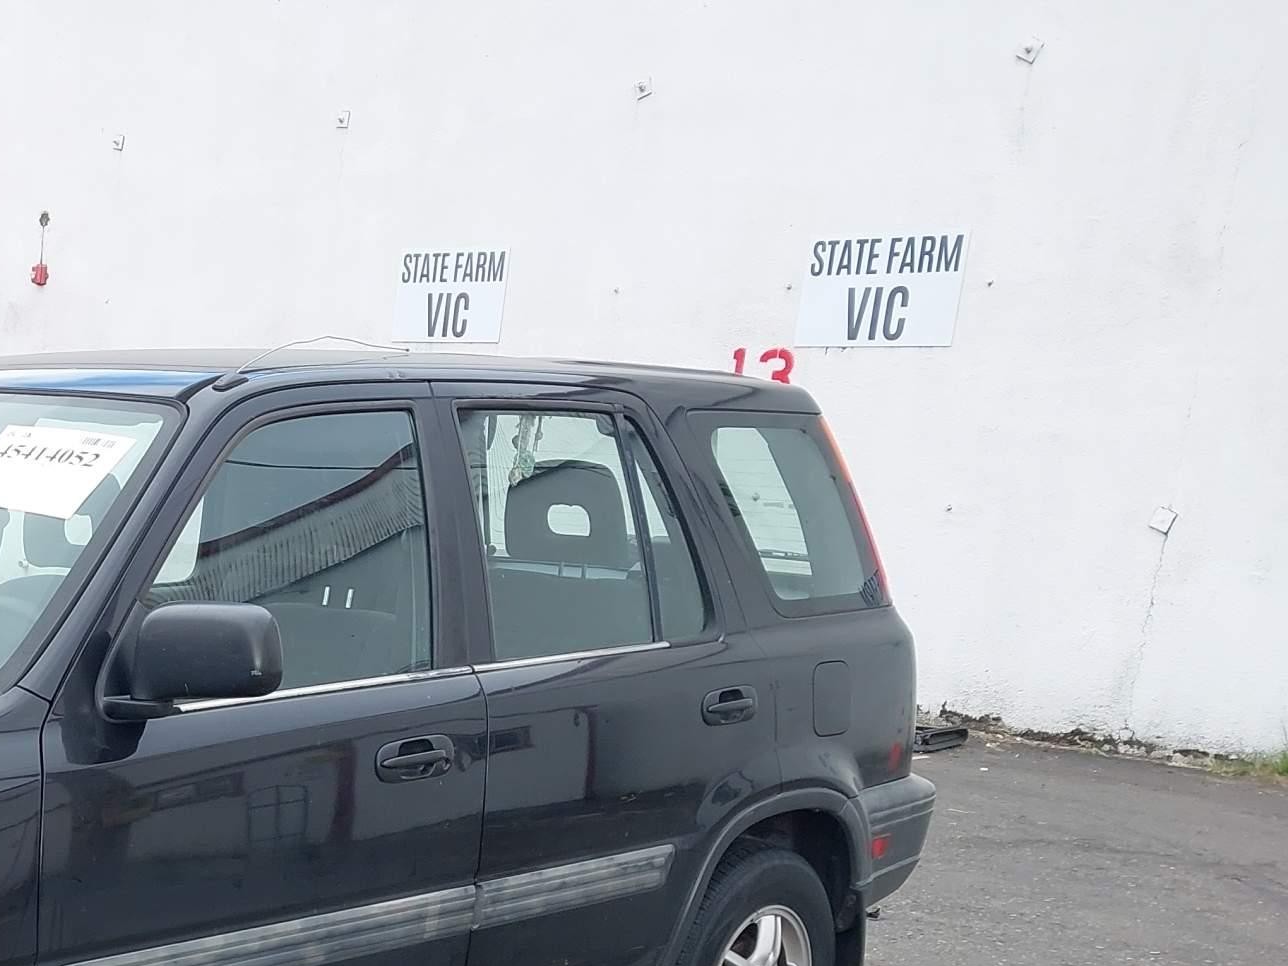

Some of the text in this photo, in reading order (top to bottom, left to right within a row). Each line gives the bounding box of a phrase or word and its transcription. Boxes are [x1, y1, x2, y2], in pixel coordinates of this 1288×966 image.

[401, 250, 506, 283] STATE FARM
[810, 234, 965, 277] STATE FARM
[427, 292, 470, 338] VIC
[846, 285, 910, 341] VIC
